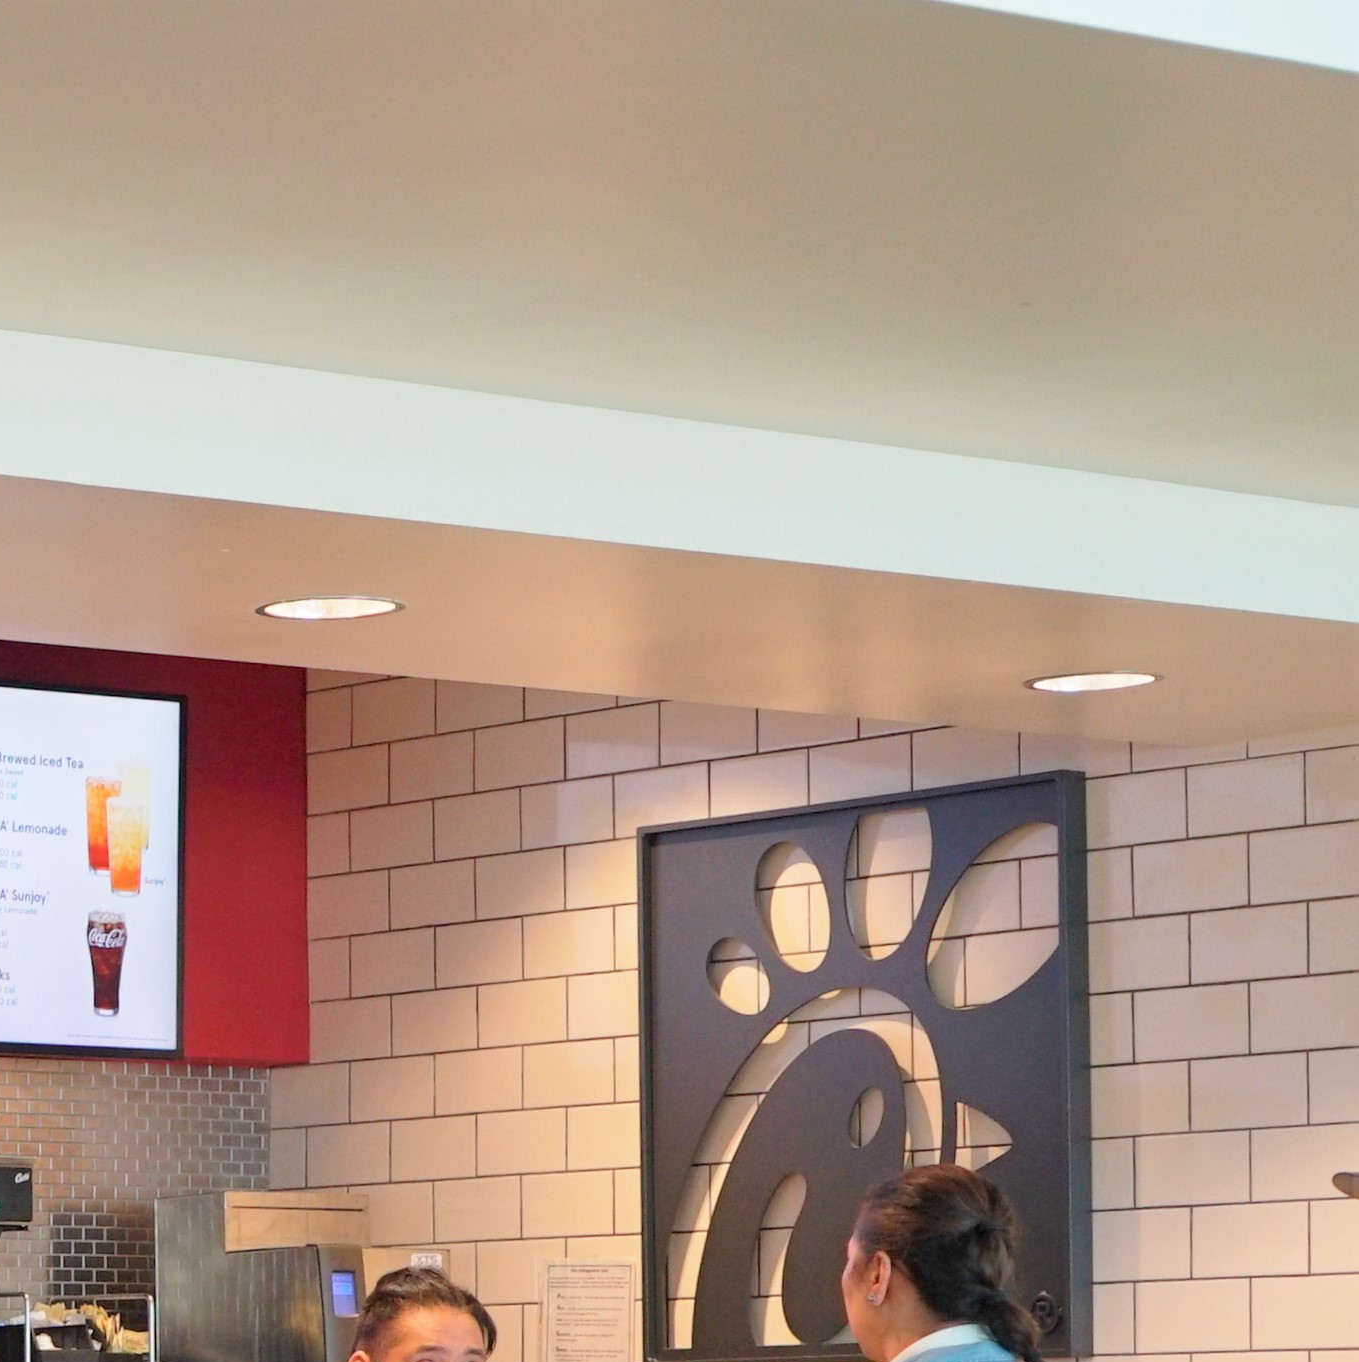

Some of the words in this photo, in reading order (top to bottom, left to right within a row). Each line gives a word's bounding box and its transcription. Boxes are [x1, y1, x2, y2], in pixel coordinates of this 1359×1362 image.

[39, 754, 63, 767] Iced
[65, 757, 84, 769] Tea
[12, 820, 67, 836] Lemonade
[12, 889, 46, 906] Sunjoy
